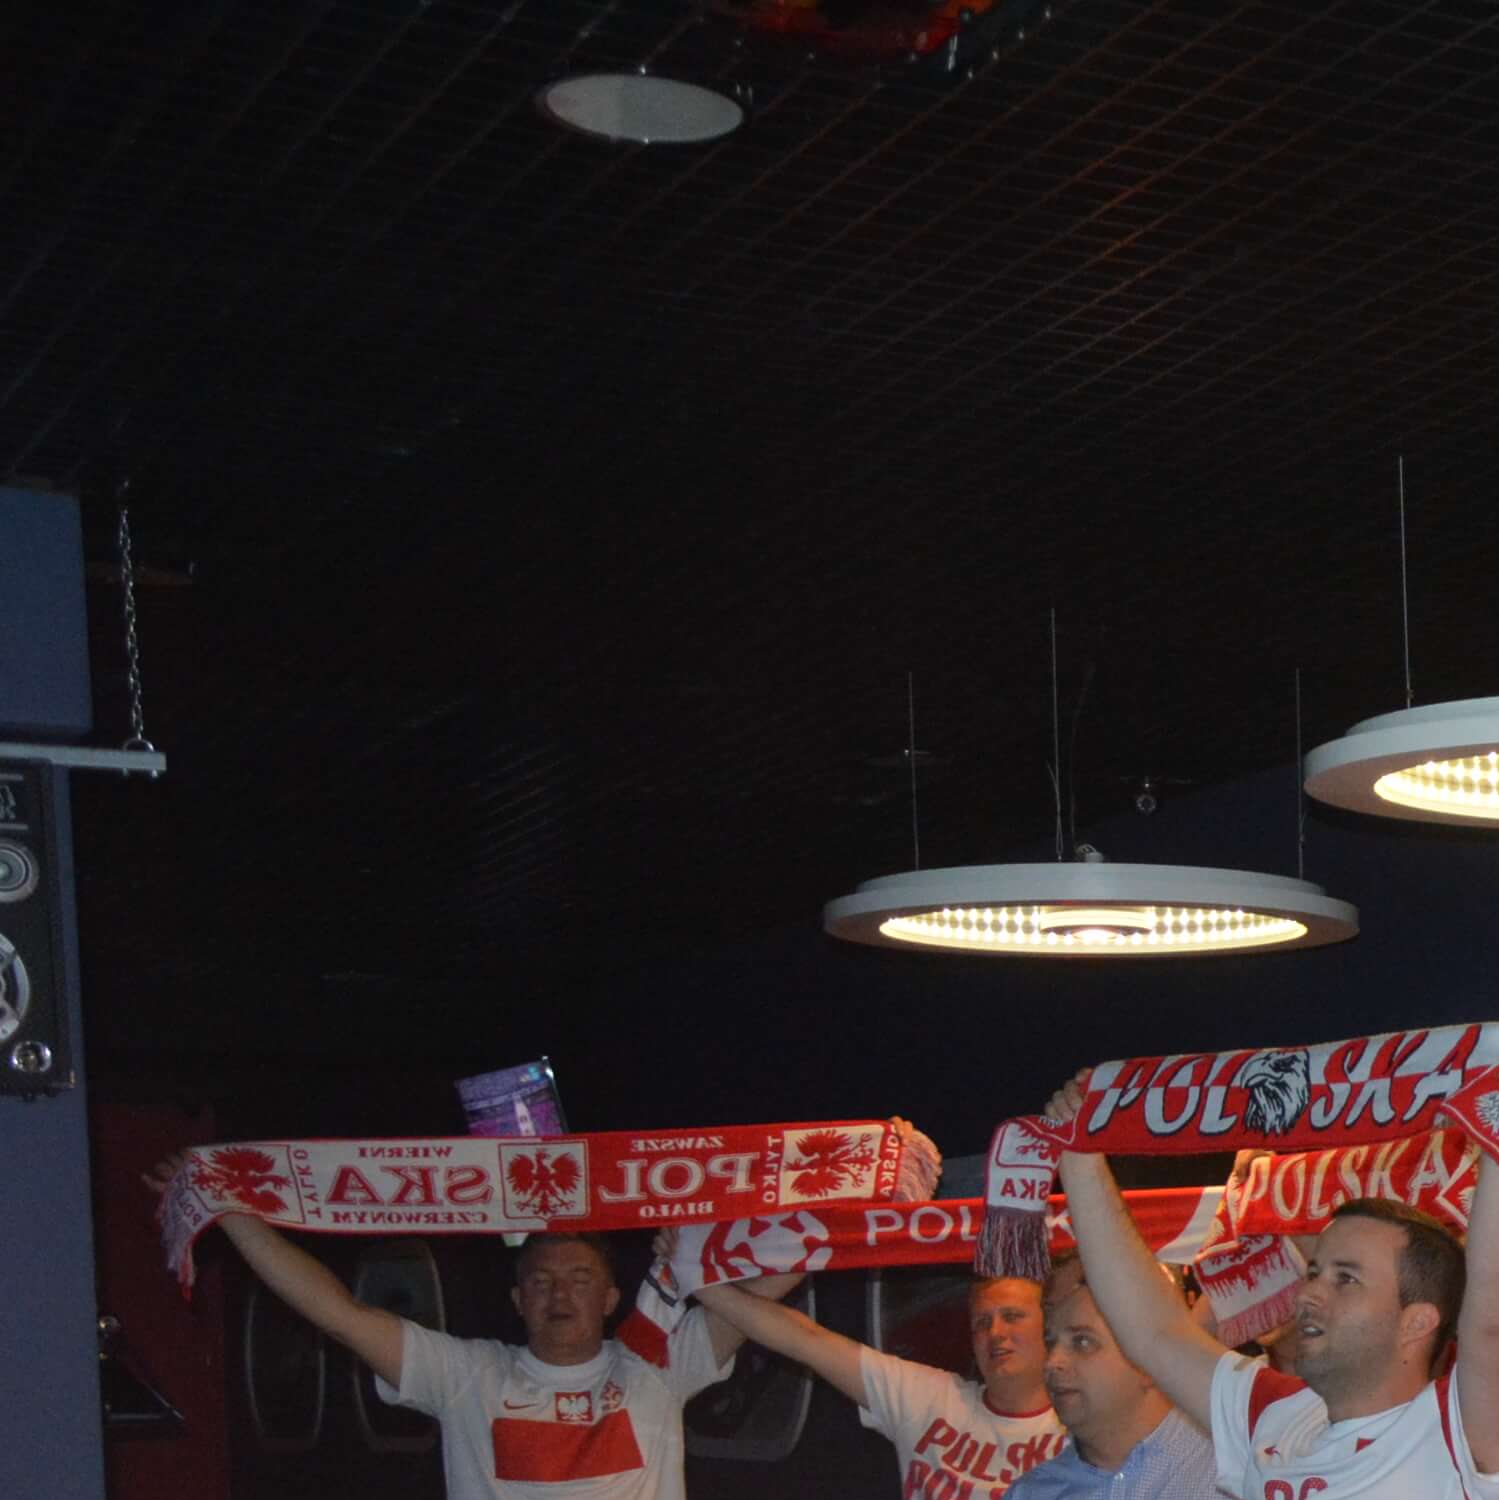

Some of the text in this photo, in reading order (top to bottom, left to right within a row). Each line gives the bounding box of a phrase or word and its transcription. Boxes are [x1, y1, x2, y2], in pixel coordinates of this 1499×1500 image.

[1087, 1024, 1482, 1137] POL SKA
[1236, 1129, 1453, 1228] POLSKA
[914, 1416, 1067, 1484] POLSK
